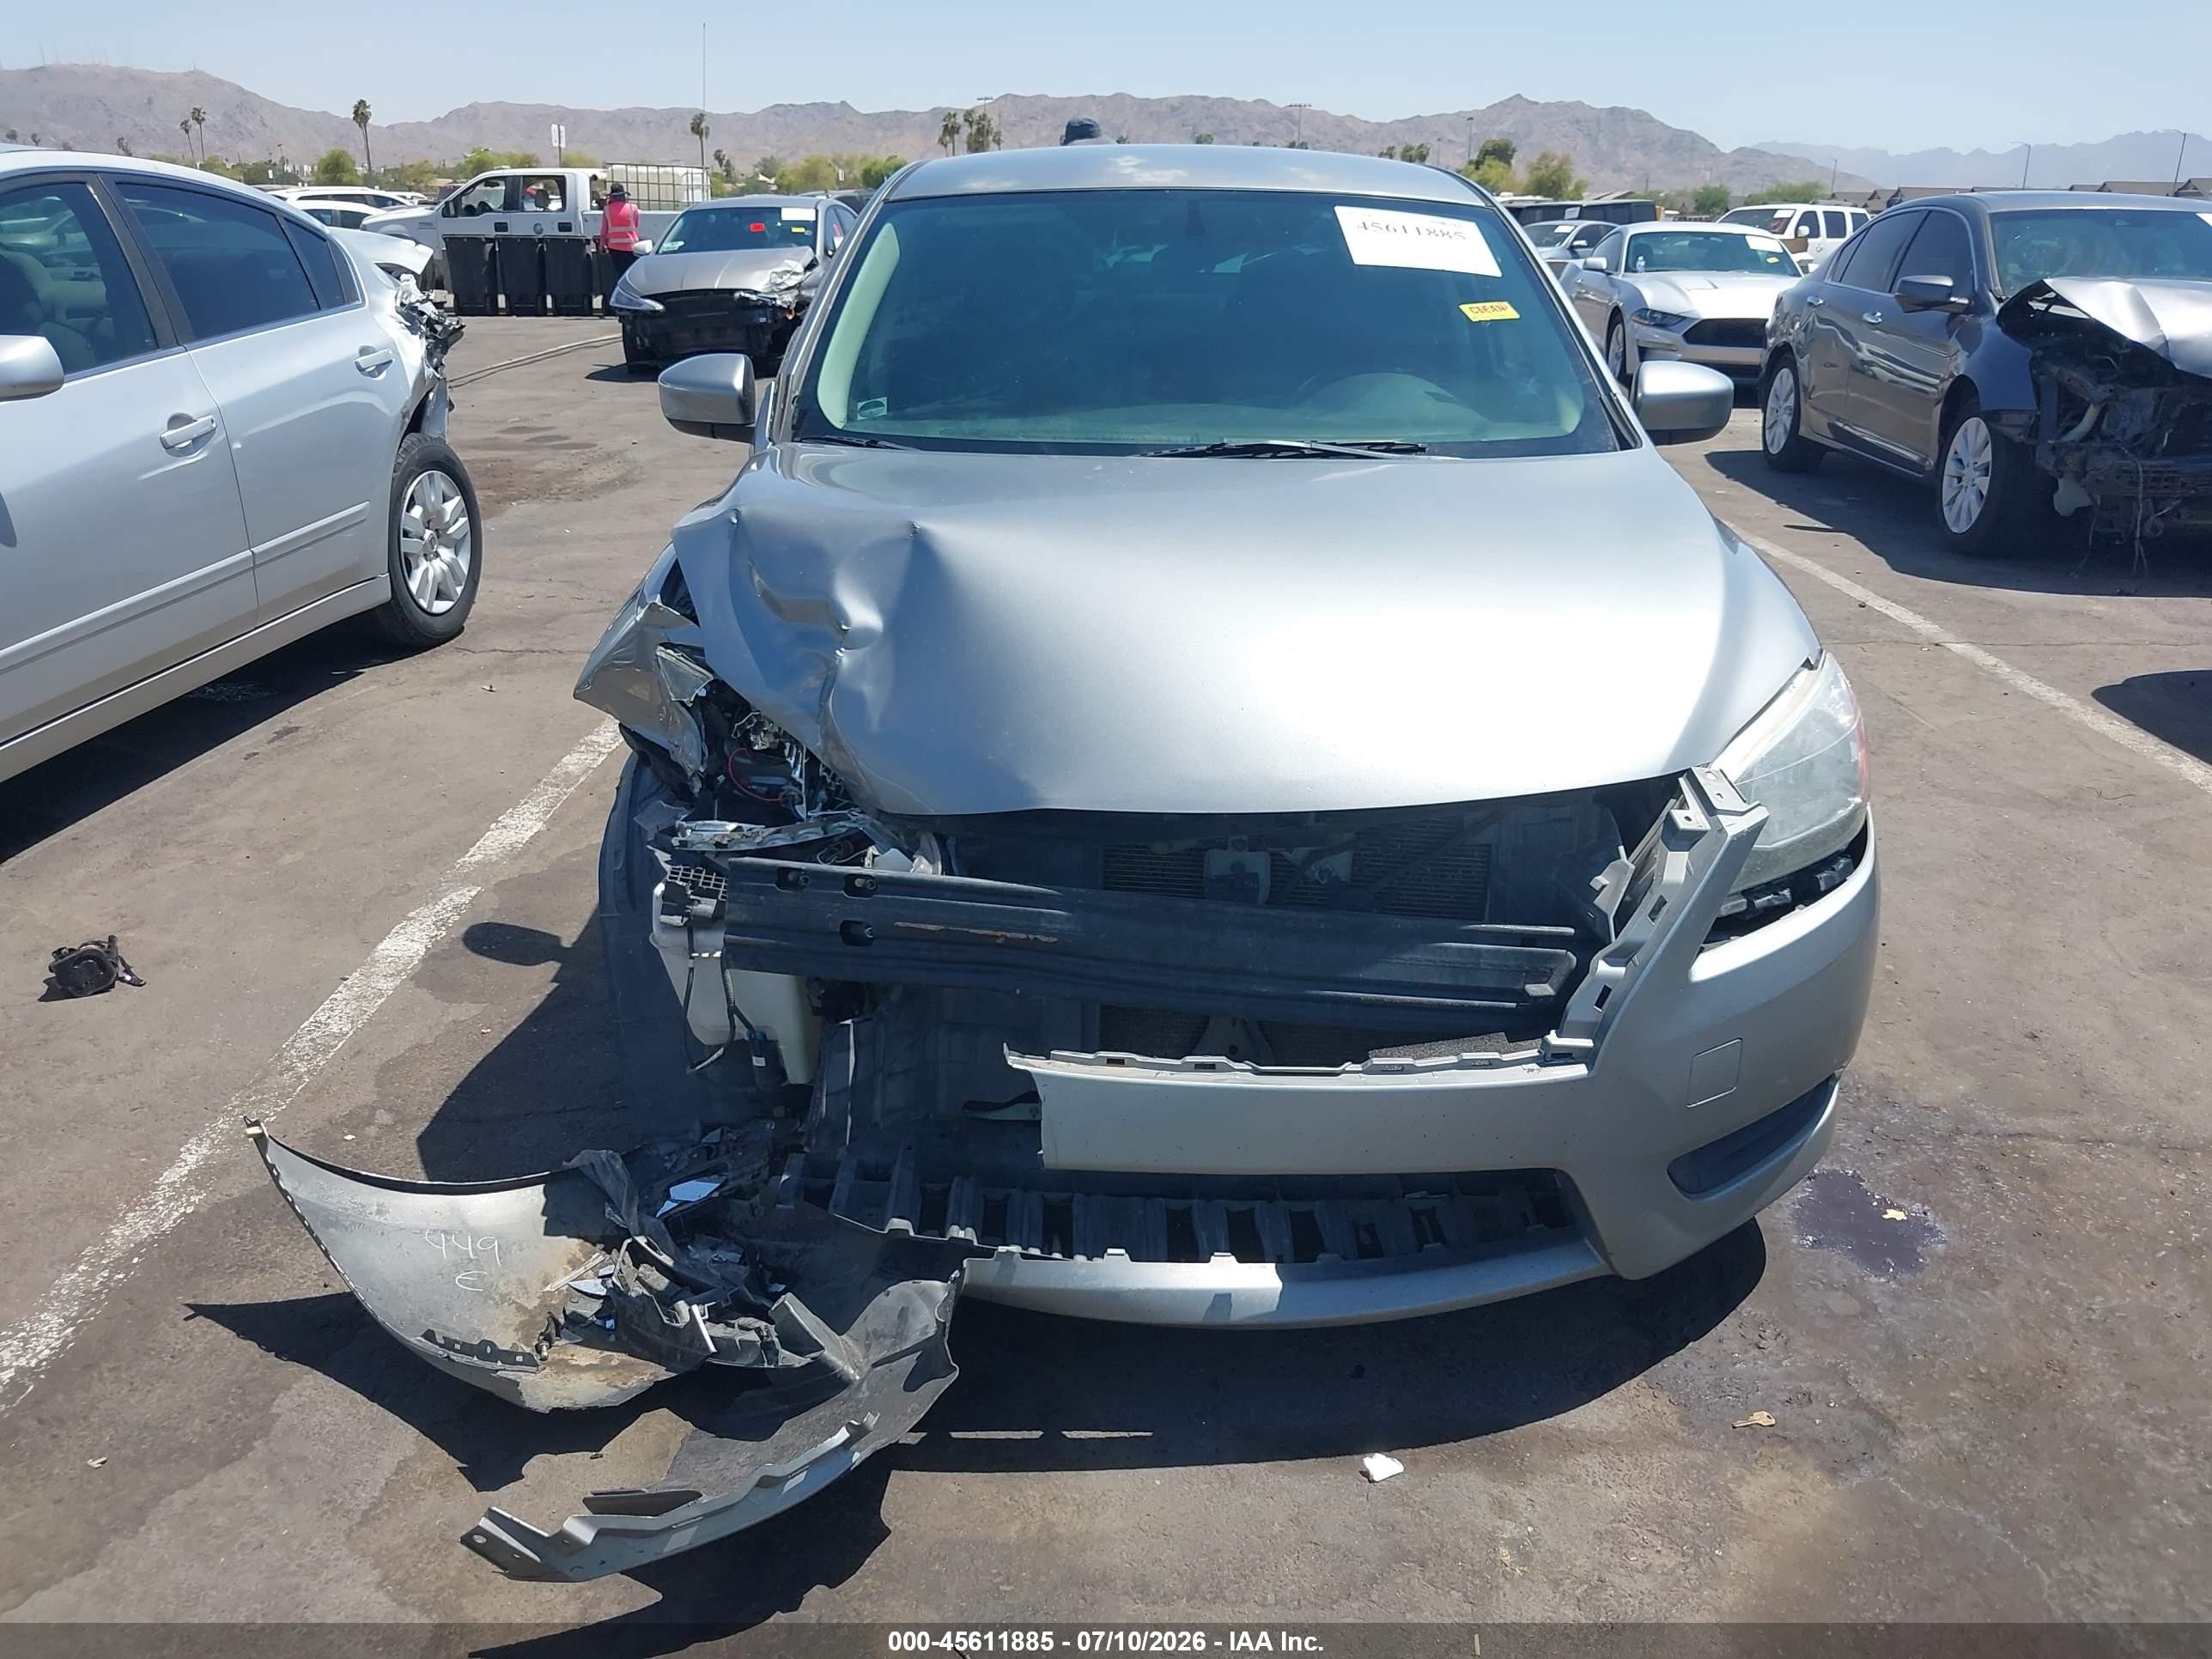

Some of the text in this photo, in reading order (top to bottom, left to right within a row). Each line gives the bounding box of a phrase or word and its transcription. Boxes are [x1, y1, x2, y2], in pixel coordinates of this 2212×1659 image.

[1357, 221, 1466, 240] 45611885
[1469, 302, 1509, 314] CLEAN
[425, 1228, 501, 1267] 449
